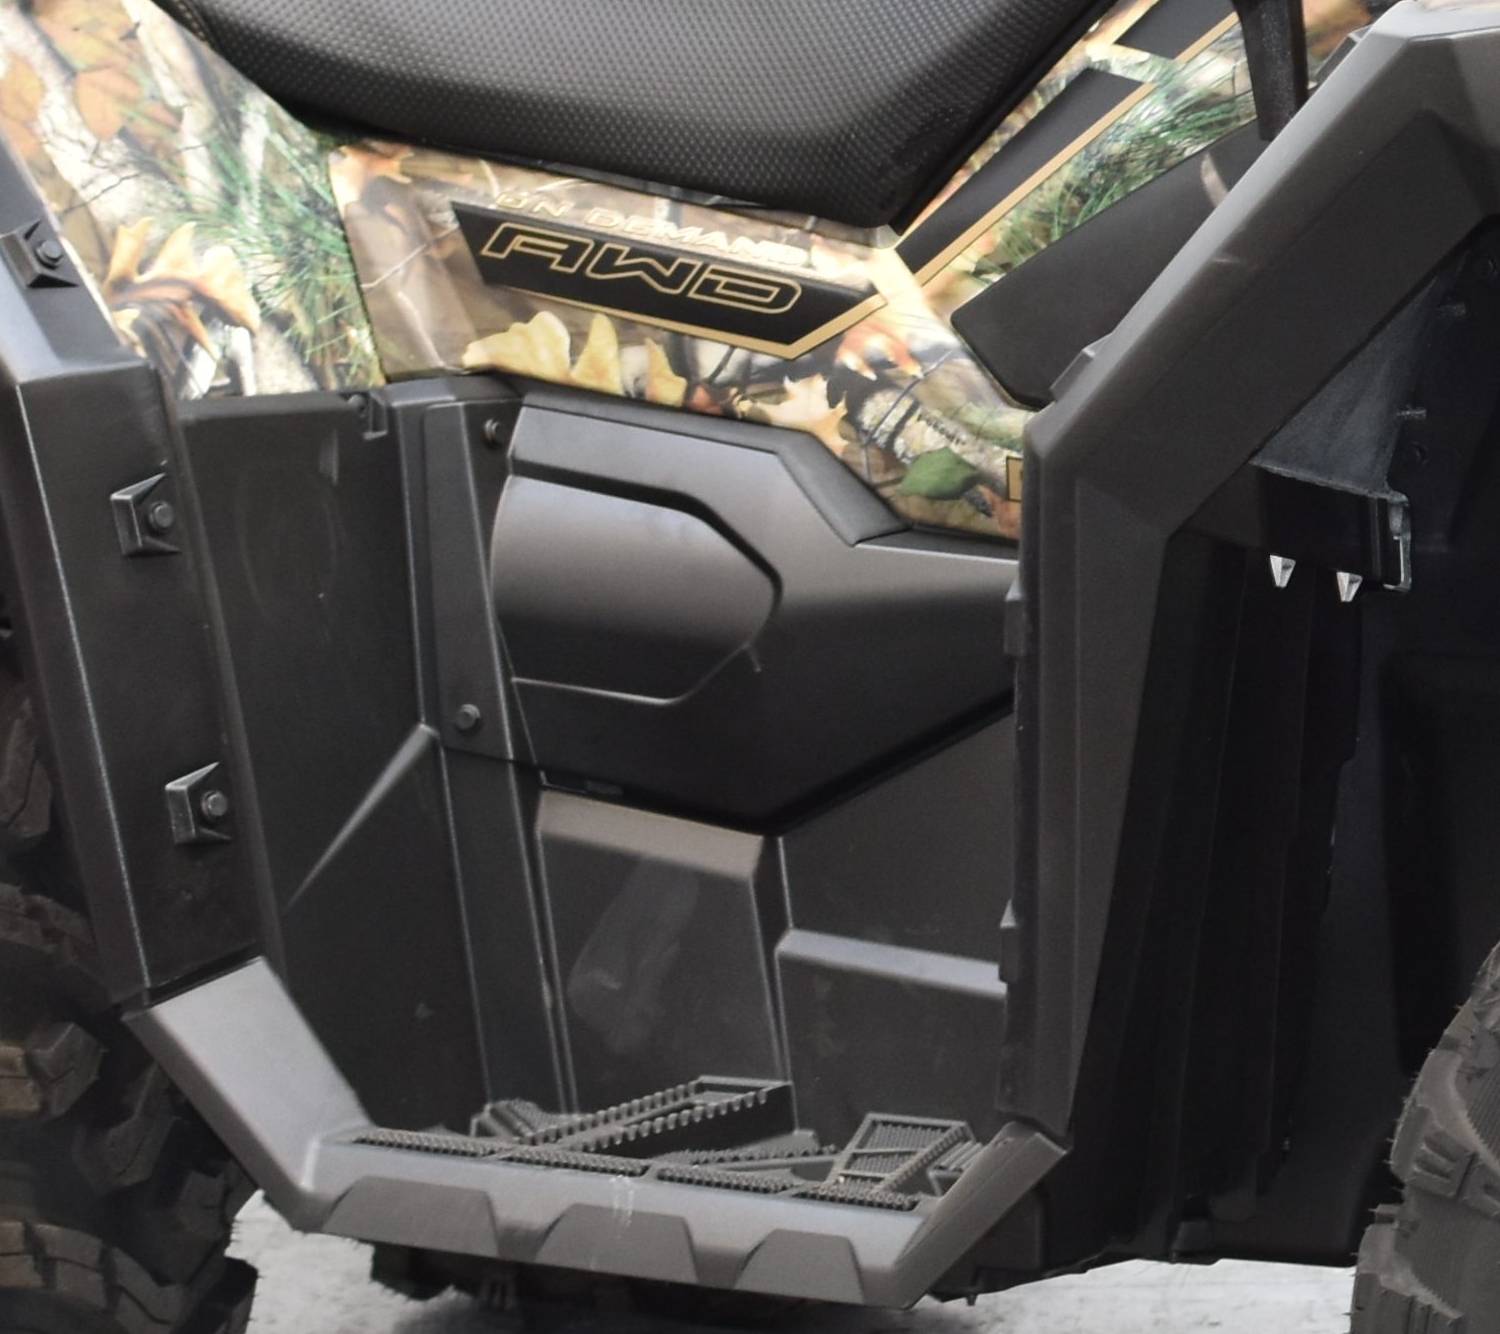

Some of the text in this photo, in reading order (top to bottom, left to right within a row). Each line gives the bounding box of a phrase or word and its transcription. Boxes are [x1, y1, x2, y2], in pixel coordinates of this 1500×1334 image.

[481, 222, 802, 314] AWD
[494, 190, 810, 267] ON DEMAND
